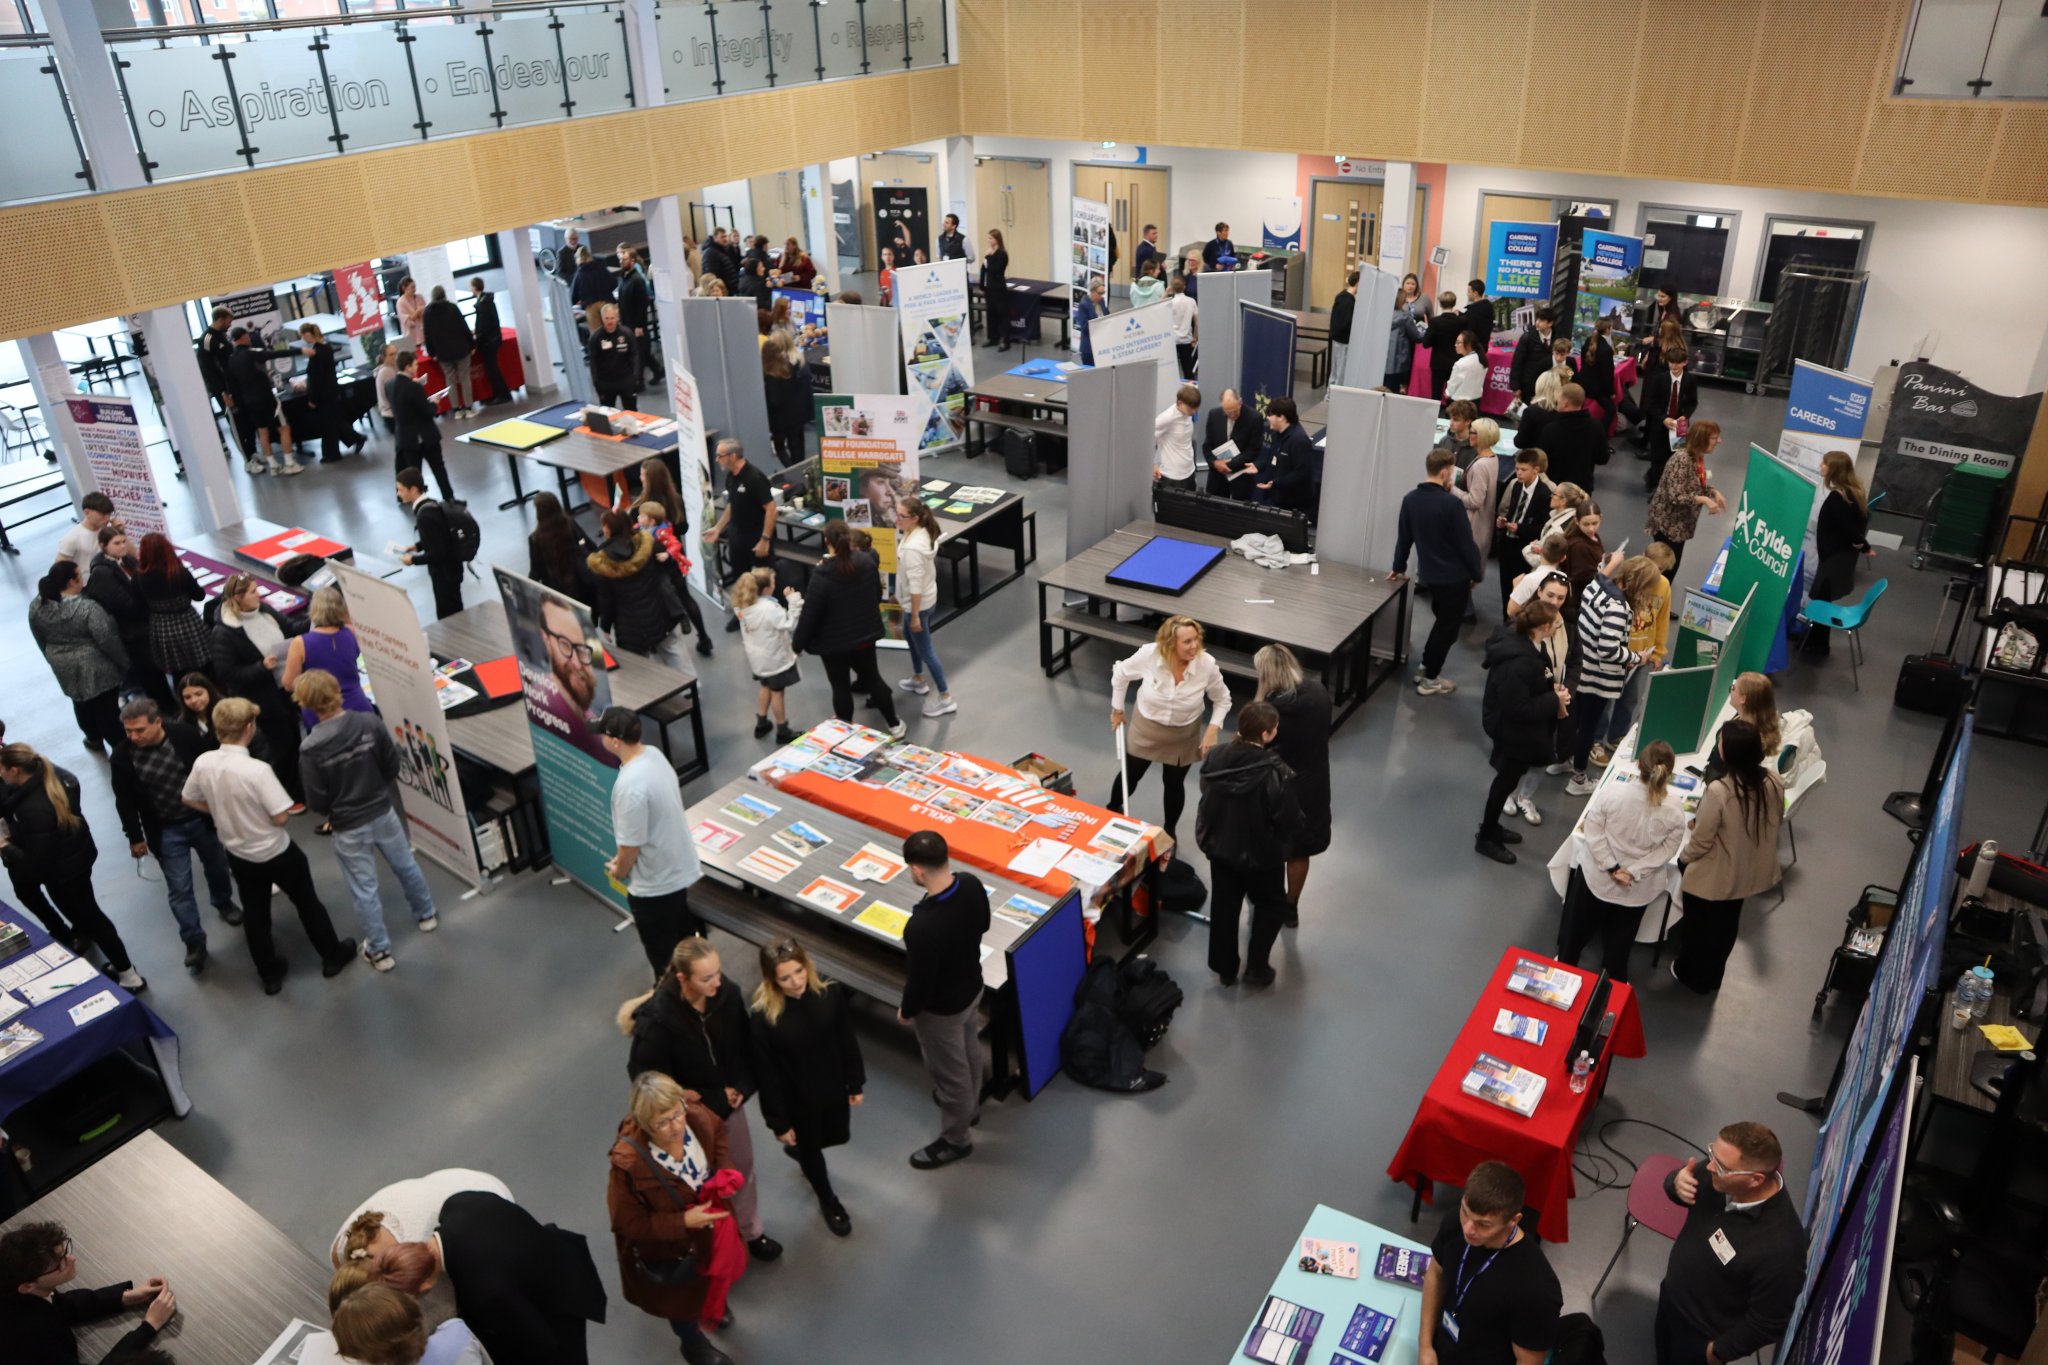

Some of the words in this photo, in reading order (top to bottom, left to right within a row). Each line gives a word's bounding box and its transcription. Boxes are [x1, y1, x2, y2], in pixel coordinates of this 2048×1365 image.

[845, 16, 925, 51] Respect
[690, 29, 793, 68] Integrity
[447, 49, 610, 98] Endeavour
[180, 74, 390, 133] Aspiration
[1355, 165, 1366, 173] No
[1367, 165, 1386, 176] Entry
[1508, 234, 1537, 242] CARDINAL
[1507, 245, 1536, 253] COLLEGE
[1597, 243, 1624, 254] CARDINAL
[1499, 258, 1542, 269] THERE'S
[1595, 256, 1623, 266] COLLEGE
[1512, 268, 1541, 276] PLACE
[1497, 274, 1541, 287] LIKE
[1496, 285, 1539, 295] NEWMAN
[1126, 334, 1164, 348] INTERESTED
[1135, 341, 1162, 353] CAREER?
[1903, 373, 1968, 397] Panini
[1912, 395, 1946, 414] Bar
[1790, 406, 1836, 431] CAREERS
[822, 439, 845, 450] ARMY
[846, 439, 896, 450] FOUNDATION
[822, 449, 857, 460] COLLEGE
[857, 450, 904, 461] HARROGATE
[1903, 441, 1926, 453] The
[1929, 446, 1969, 463] Dining
[1973, 453, 2009, 468] Room
[111, 468, 150, 481] MIDWIFE
[100, 487, 142, 501] TEACHER
[1754, 518, 1792, 559] Fylde
[1749, 538, 1788, 578] Council
[518, 660, 559, 696] Develop
[525, 698, 572, 735] Progress
[909, 803, 957, 824] SKILLS
[1043, 802, 1099, 826] INSPIRE
[1395, 1248, 1411, 1277] CAREER
